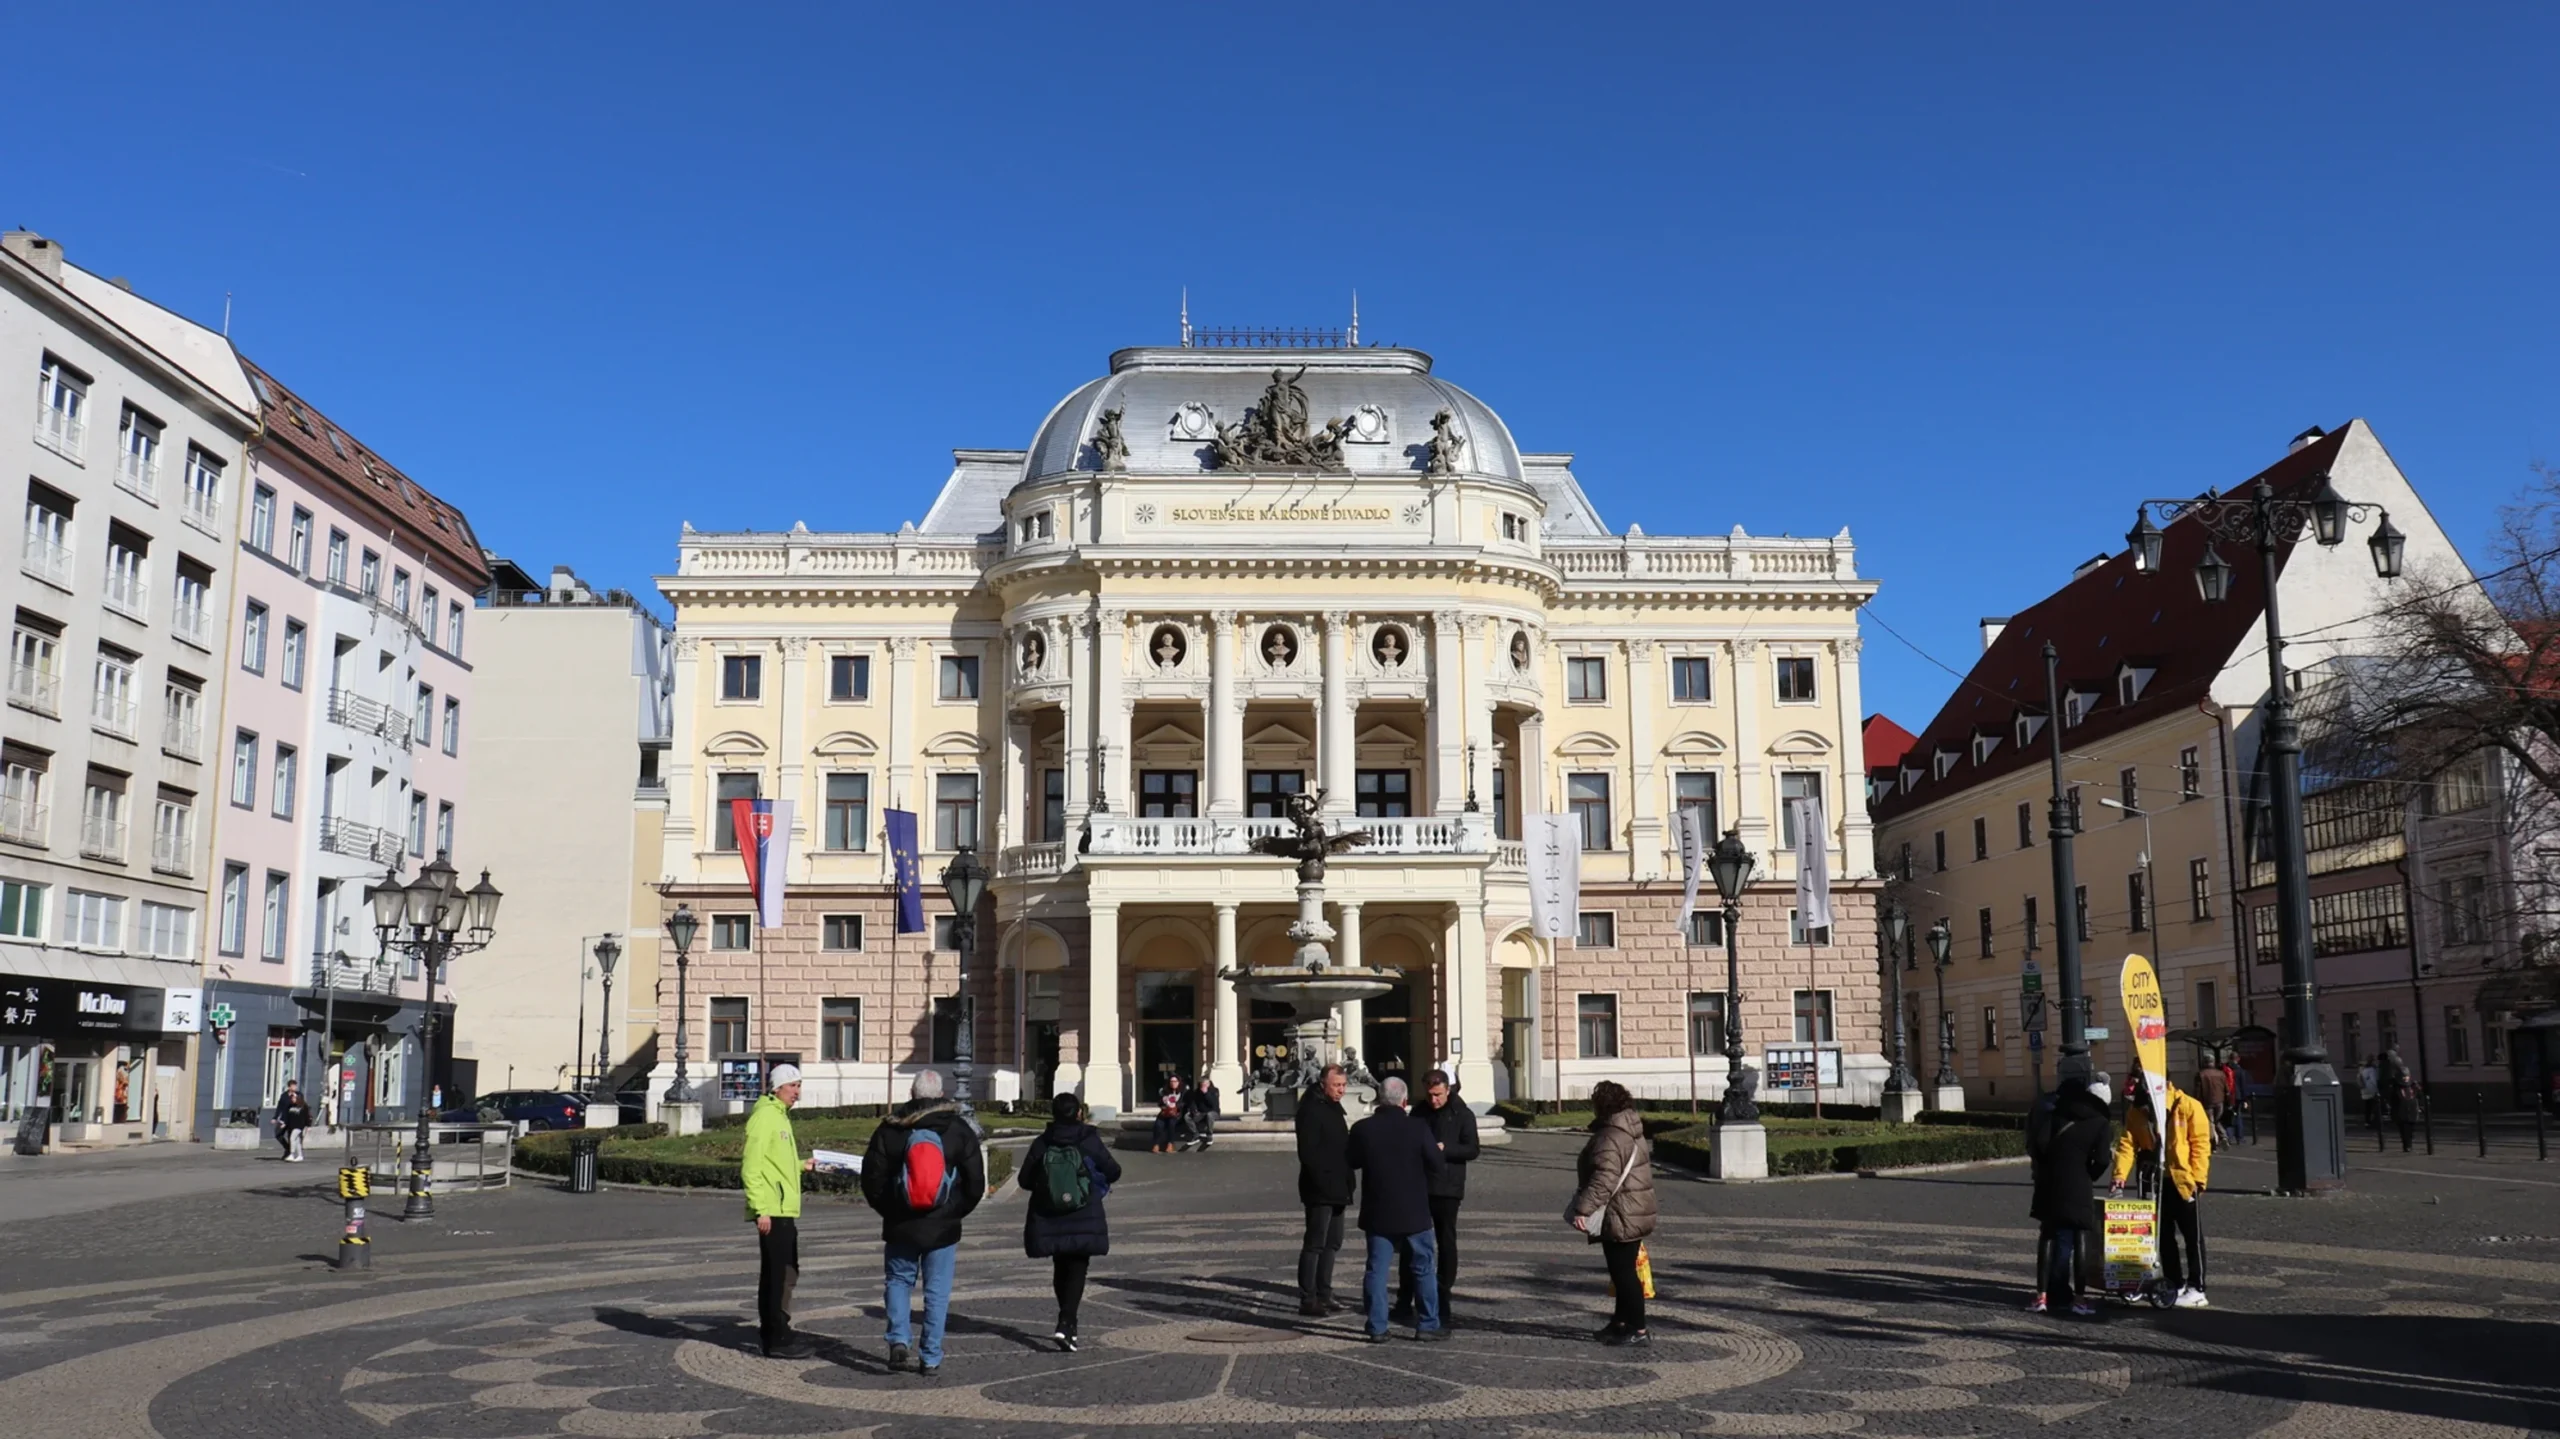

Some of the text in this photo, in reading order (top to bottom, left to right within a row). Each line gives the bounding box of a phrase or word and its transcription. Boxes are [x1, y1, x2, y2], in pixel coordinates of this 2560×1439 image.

[1172, 507, 1255, 521] SLOVENSKÉ
[1332, 508, 1390, 521] DIVADLO
[2132, 971, 2150, 989] CITY
[2128, 992, 2158, 1010] TOURS
[2107, 1212, 2131, 1220] TICKET
